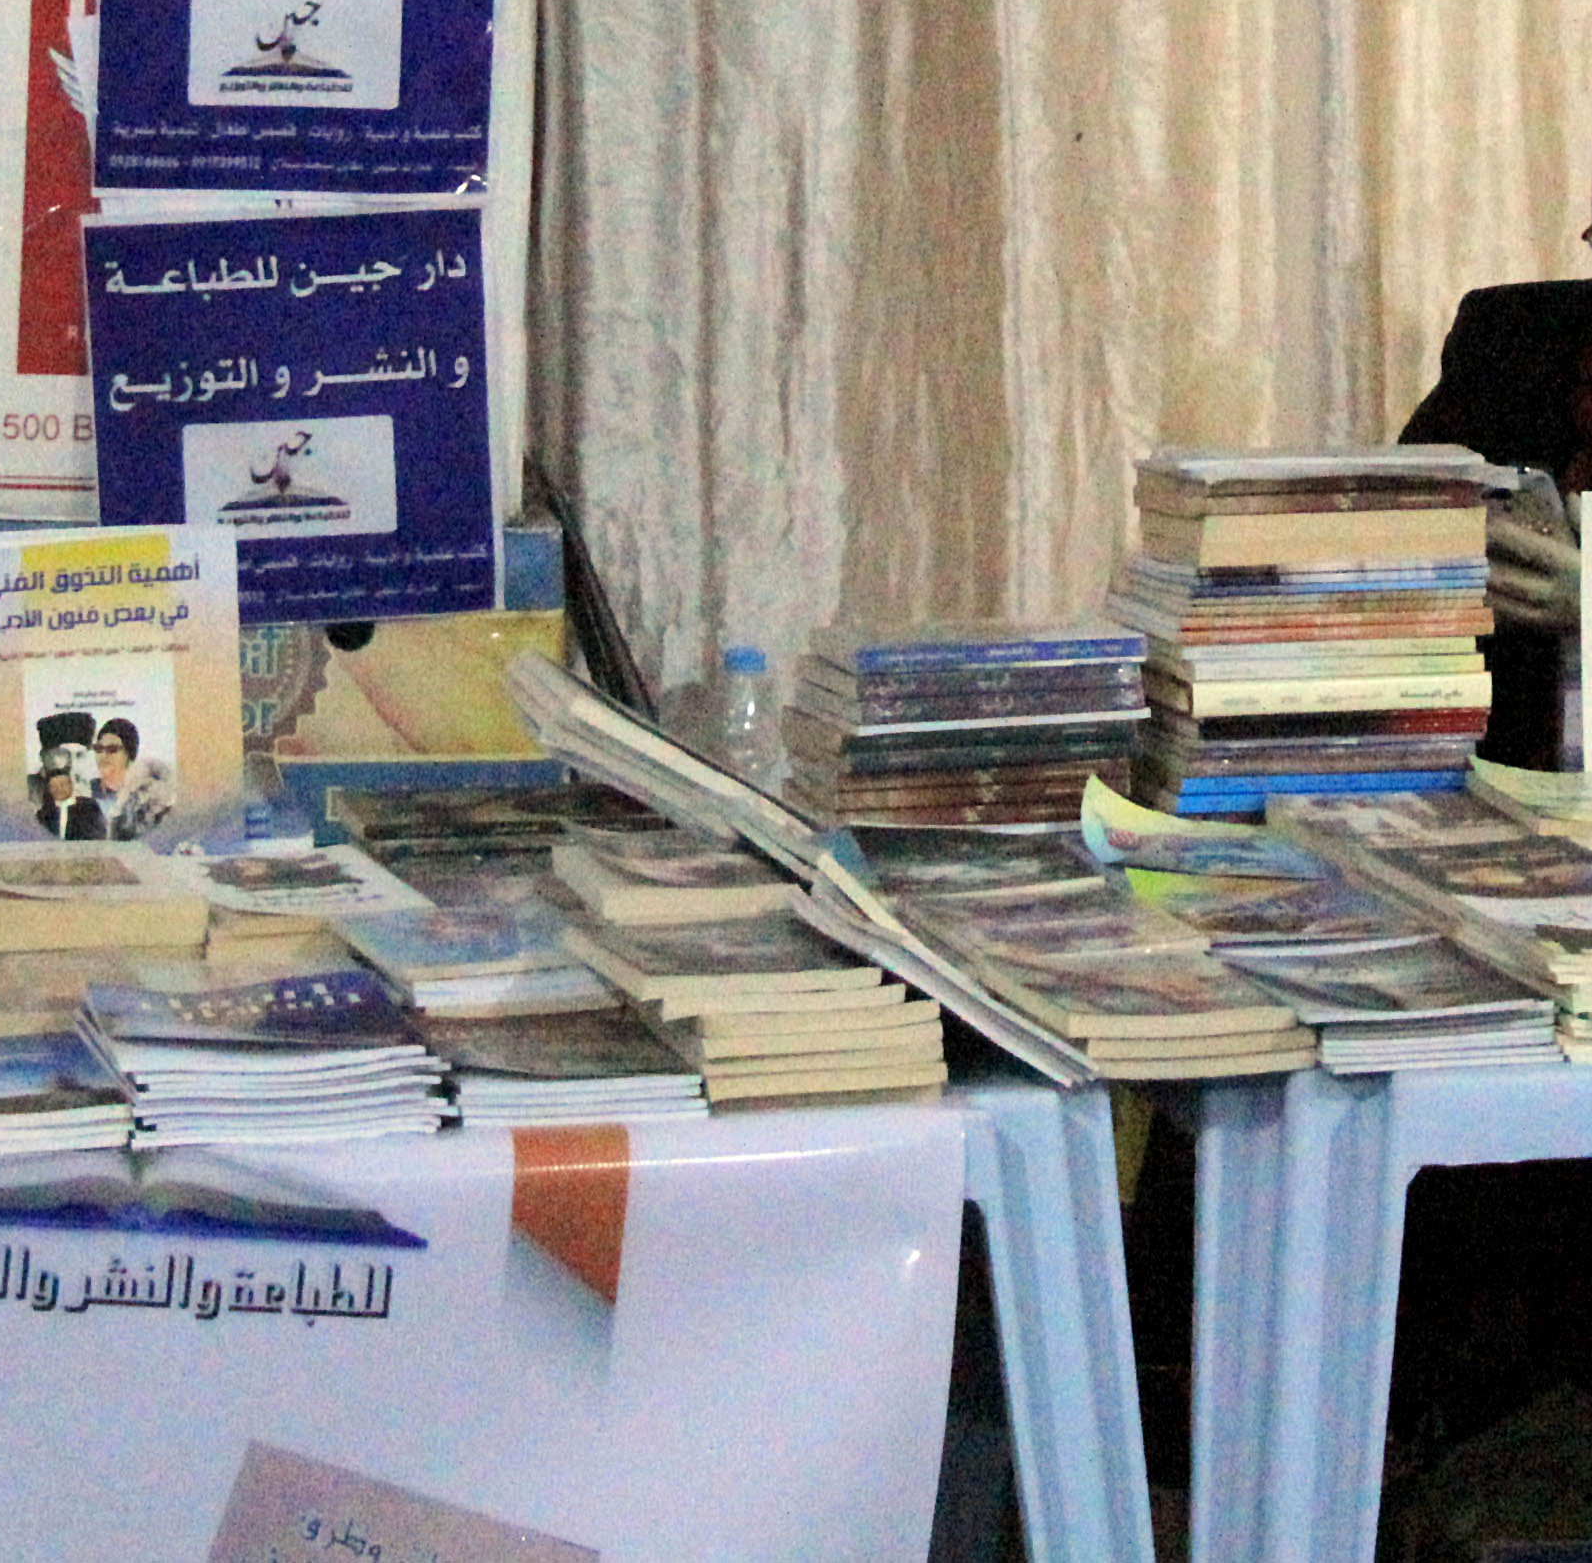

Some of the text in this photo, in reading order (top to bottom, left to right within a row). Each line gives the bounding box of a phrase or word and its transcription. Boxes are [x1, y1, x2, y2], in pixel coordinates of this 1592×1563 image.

[104, 250, 469, 302] دار جين للطباعة
[109, 346, 470, 412] و النشر و التوزيع
[1, 413, 61, 441] 500
[127, 552, 201, 588] أهمية
[47, 606, 100, 632] فنون
[103, 603, 156, 628] بعض
[159, 600, 190, 632] في
[64, 1253, 220, 1320] والنشر
[228, 1259, 393, 1327] للطباعة
